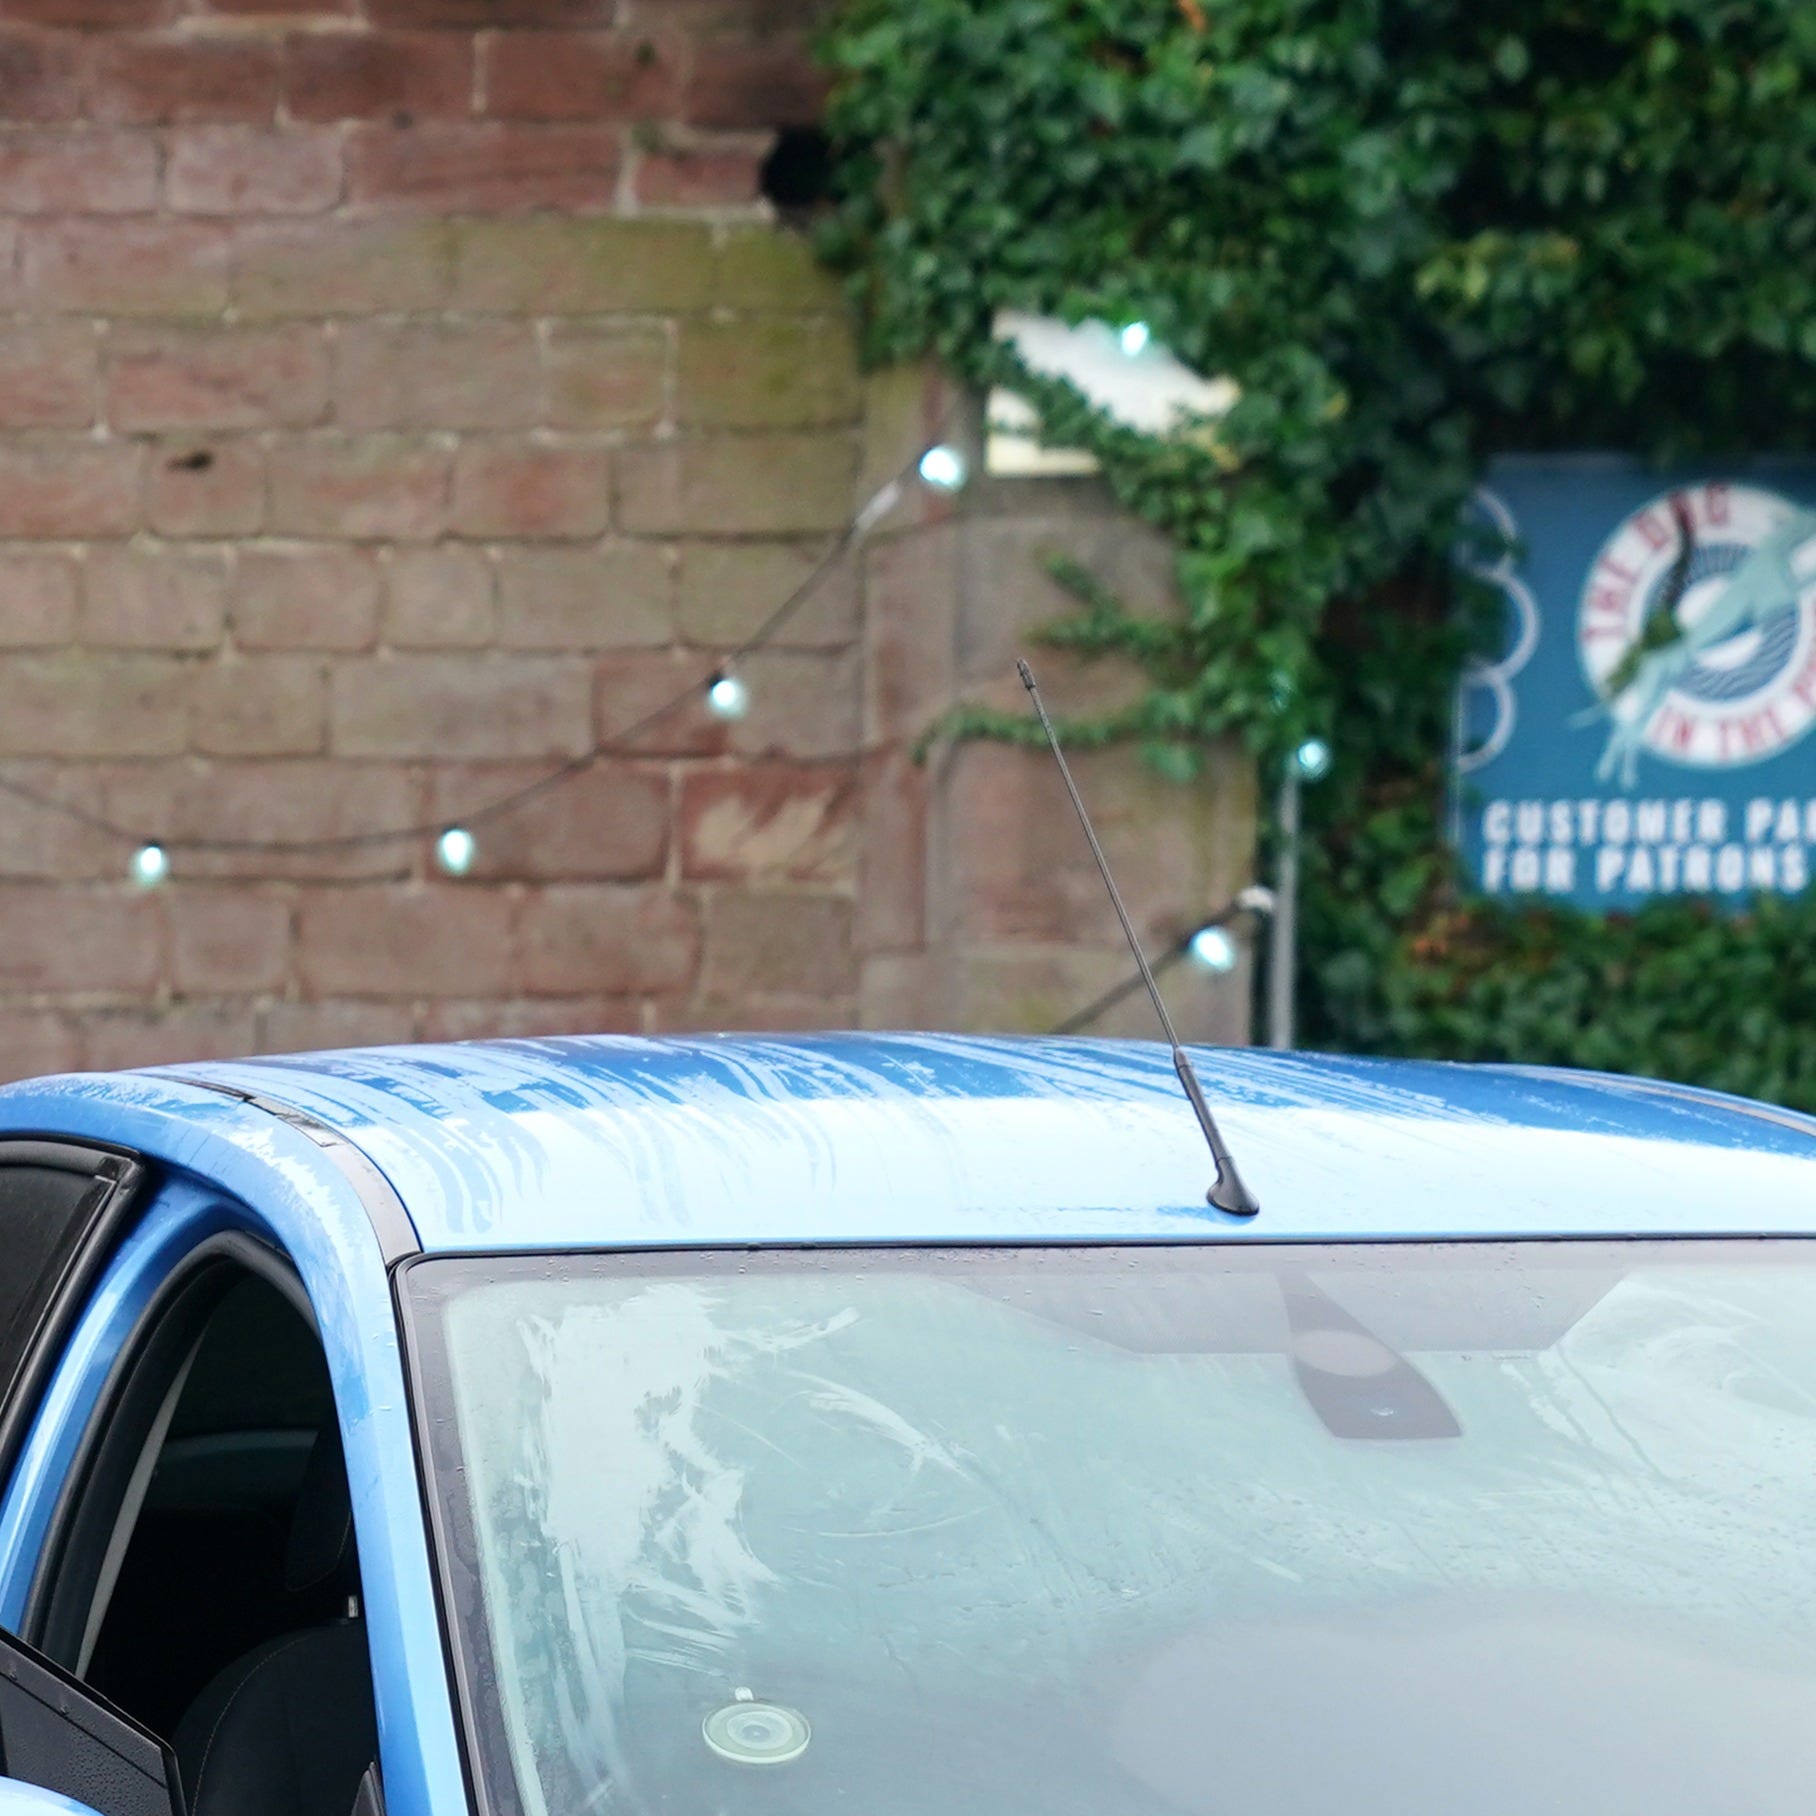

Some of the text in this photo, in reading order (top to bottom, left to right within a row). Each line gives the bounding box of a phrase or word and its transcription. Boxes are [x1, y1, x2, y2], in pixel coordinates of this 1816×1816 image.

[1482, 801, 1728, 845] CUSTOMER
[1482, 845, 1809, 893] FOR PATRONS
